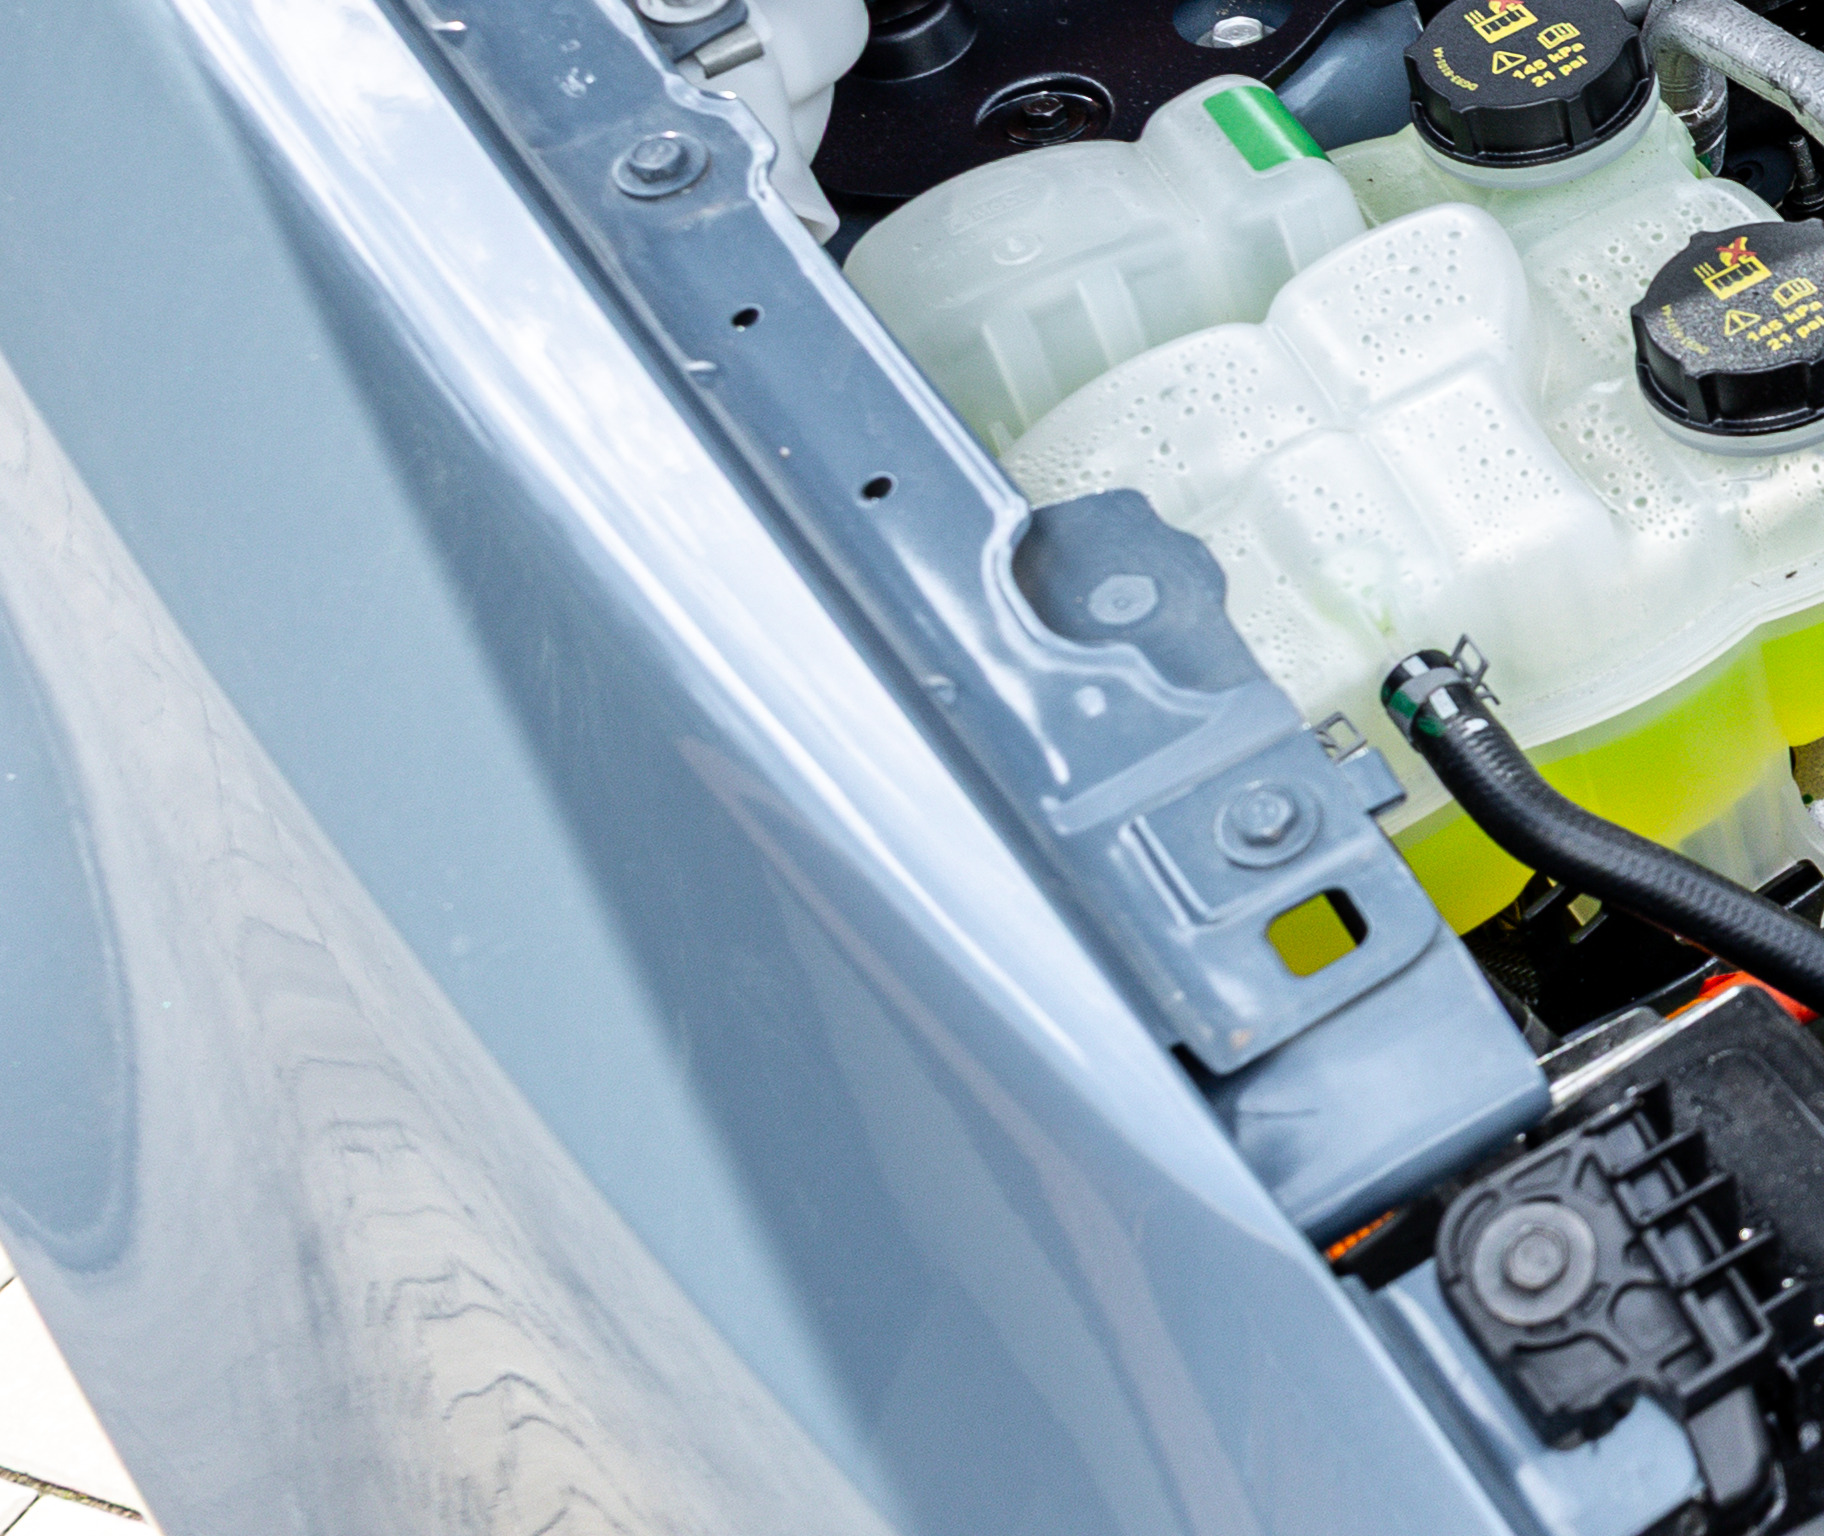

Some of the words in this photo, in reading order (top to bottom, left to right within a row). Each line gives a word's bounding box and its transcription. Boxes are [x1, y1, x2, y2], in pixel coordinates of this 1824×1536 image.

[1512, 59, 1547, 80] 145
[1547, 42, 1585, 63] kPa
[1531, 70, 1556, 88] 21
[1559, 55, 1588, 77] psi
[1747, 319, 1784, 341] 145
[1783, 301, 1823, 324] kPa
[1766, 333, 1793, 351] 21
